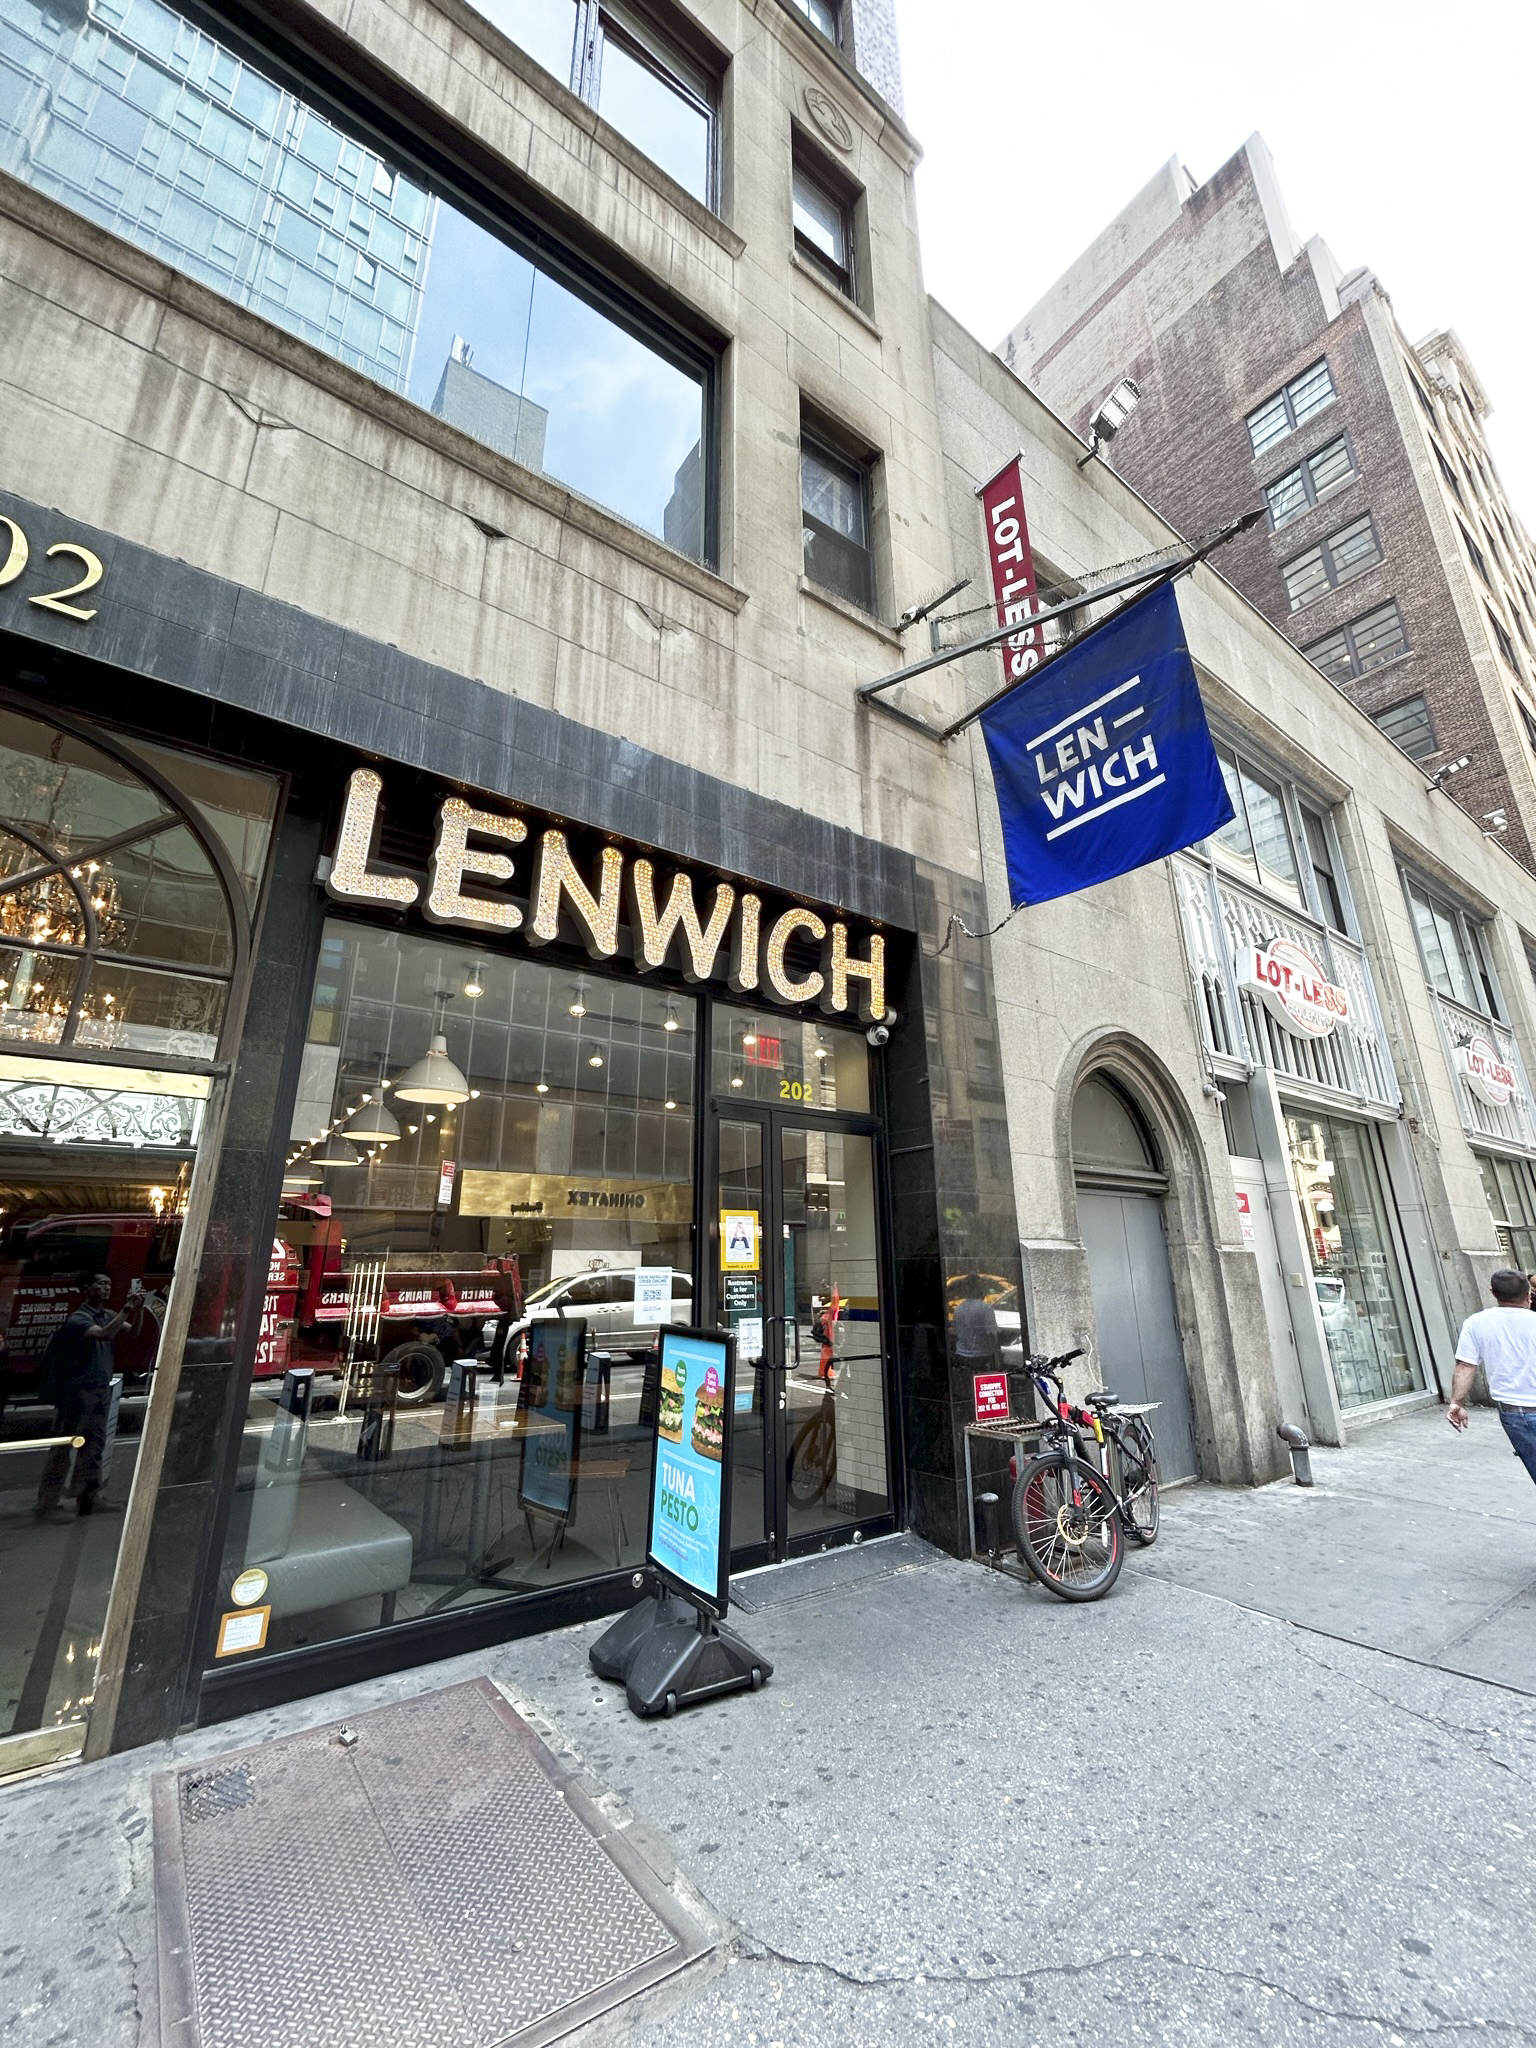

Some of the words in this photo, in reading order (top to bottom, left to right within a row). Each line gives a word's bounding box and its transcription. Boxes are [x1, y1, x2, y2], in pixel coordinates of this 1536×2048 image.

[991, 496, 1038, 678] LOT-LESS
[1040, 734, 1158, 820] WICH
[327, 768, 885, 1022] LENWICH
[1255, 952, 1347, 1016] LOT-LESS
[1466, 1051, 1514, 1088] LOT-LESS
[780, 1080, 813, 1102] 202
[733, 1299, 747, 1307] Only
[979, 1389, 1004, 1398] CONNECTION
[988, 1396, 996, 1404] FOR
[662, 1461, 696, 1503] TUNA
[661, 1489, 699, 1532] PESTO
